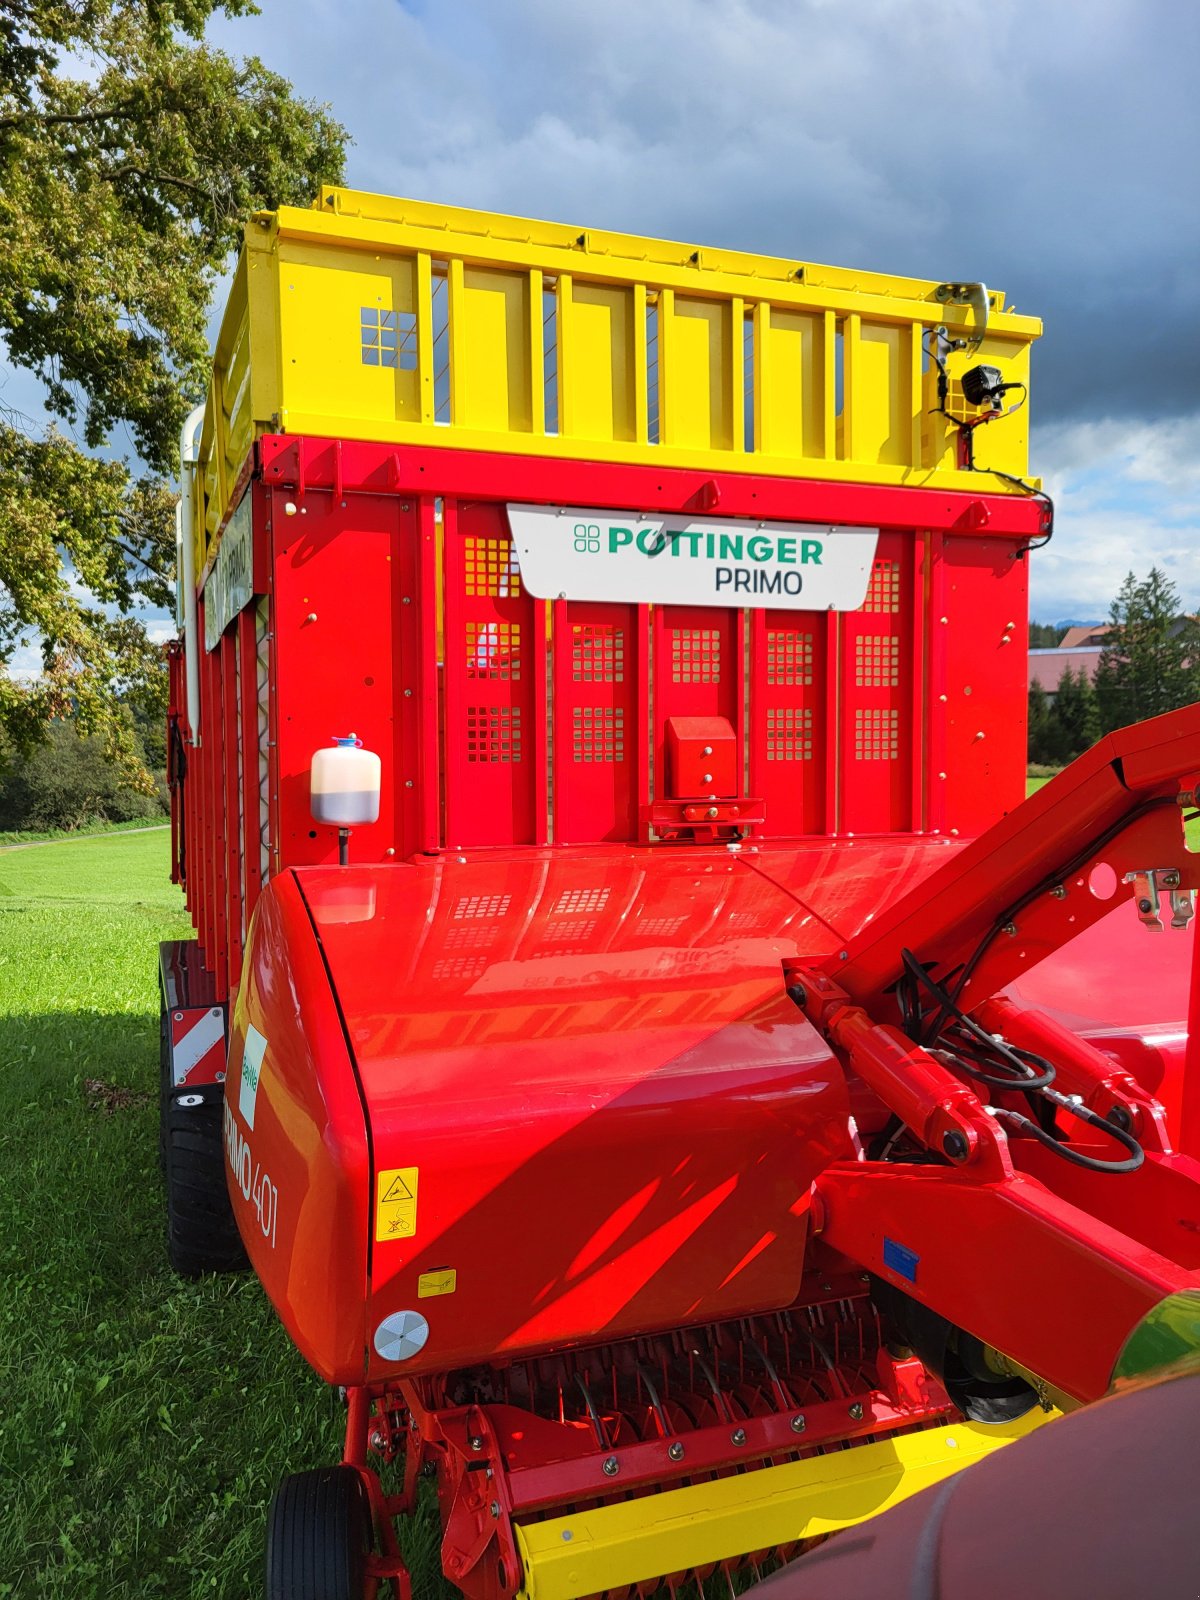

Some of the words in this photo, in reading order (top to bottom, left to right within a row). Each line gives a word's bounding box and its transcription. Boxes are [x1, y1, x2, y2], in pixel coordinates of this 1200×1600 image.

[715, 567, 803, 595] PRIMO
[223, 1093, 252, 1201] PRIMO
[252, 1162, 278, 1249] 401
